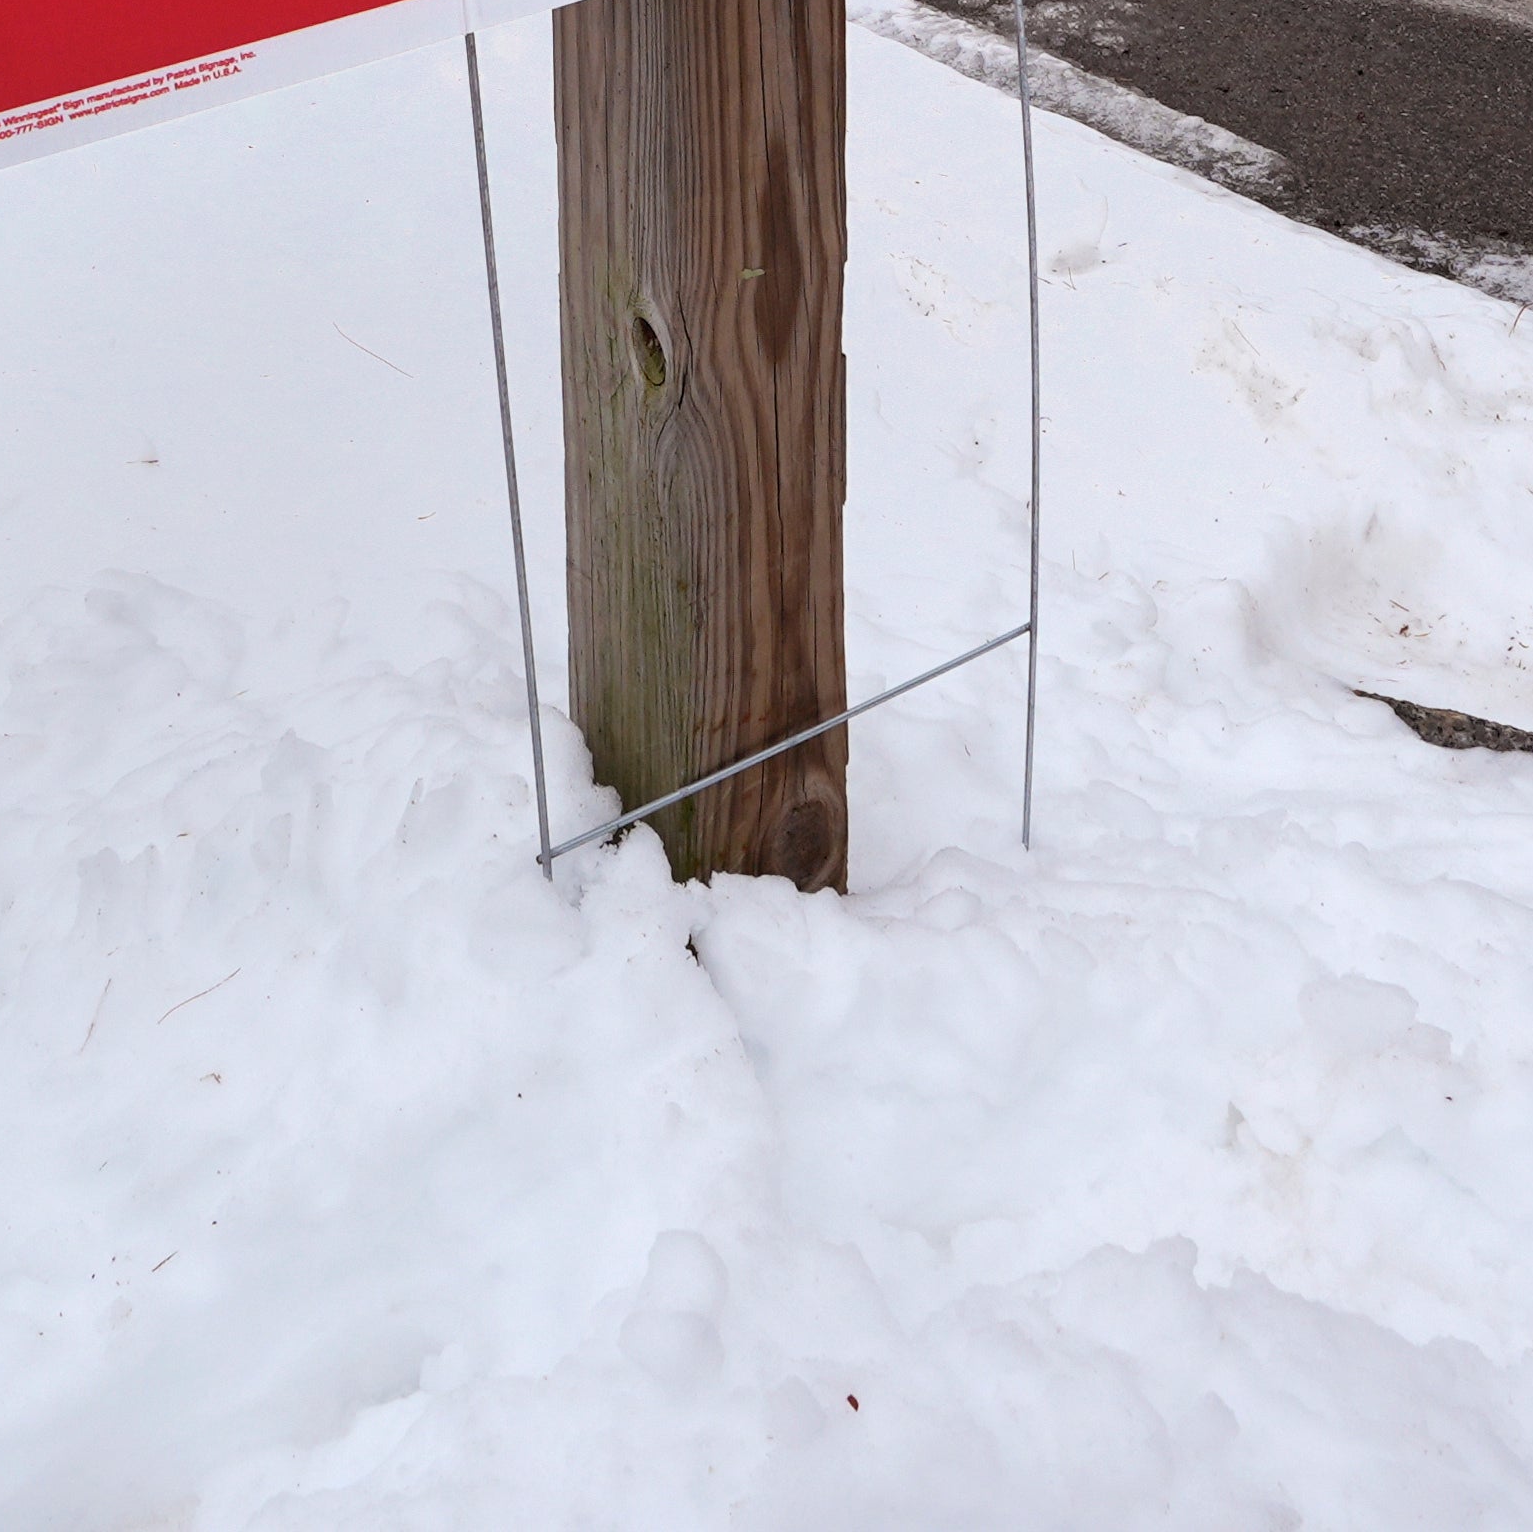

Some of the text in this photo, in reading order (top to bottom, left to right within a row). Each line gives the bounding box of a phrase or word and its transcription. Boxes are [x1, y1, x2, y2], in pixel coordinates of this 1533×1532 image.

[62, 99, 85, 111] Sign
[86, 78, 151, 103] manufactured
[152, 76, 165, 86] by
[166, 66, 196, 81] Patriot
[240, 51, 257, 61] Inc.
[174, 77, 201, 90] Made
[202, 74, 211, 83] in
